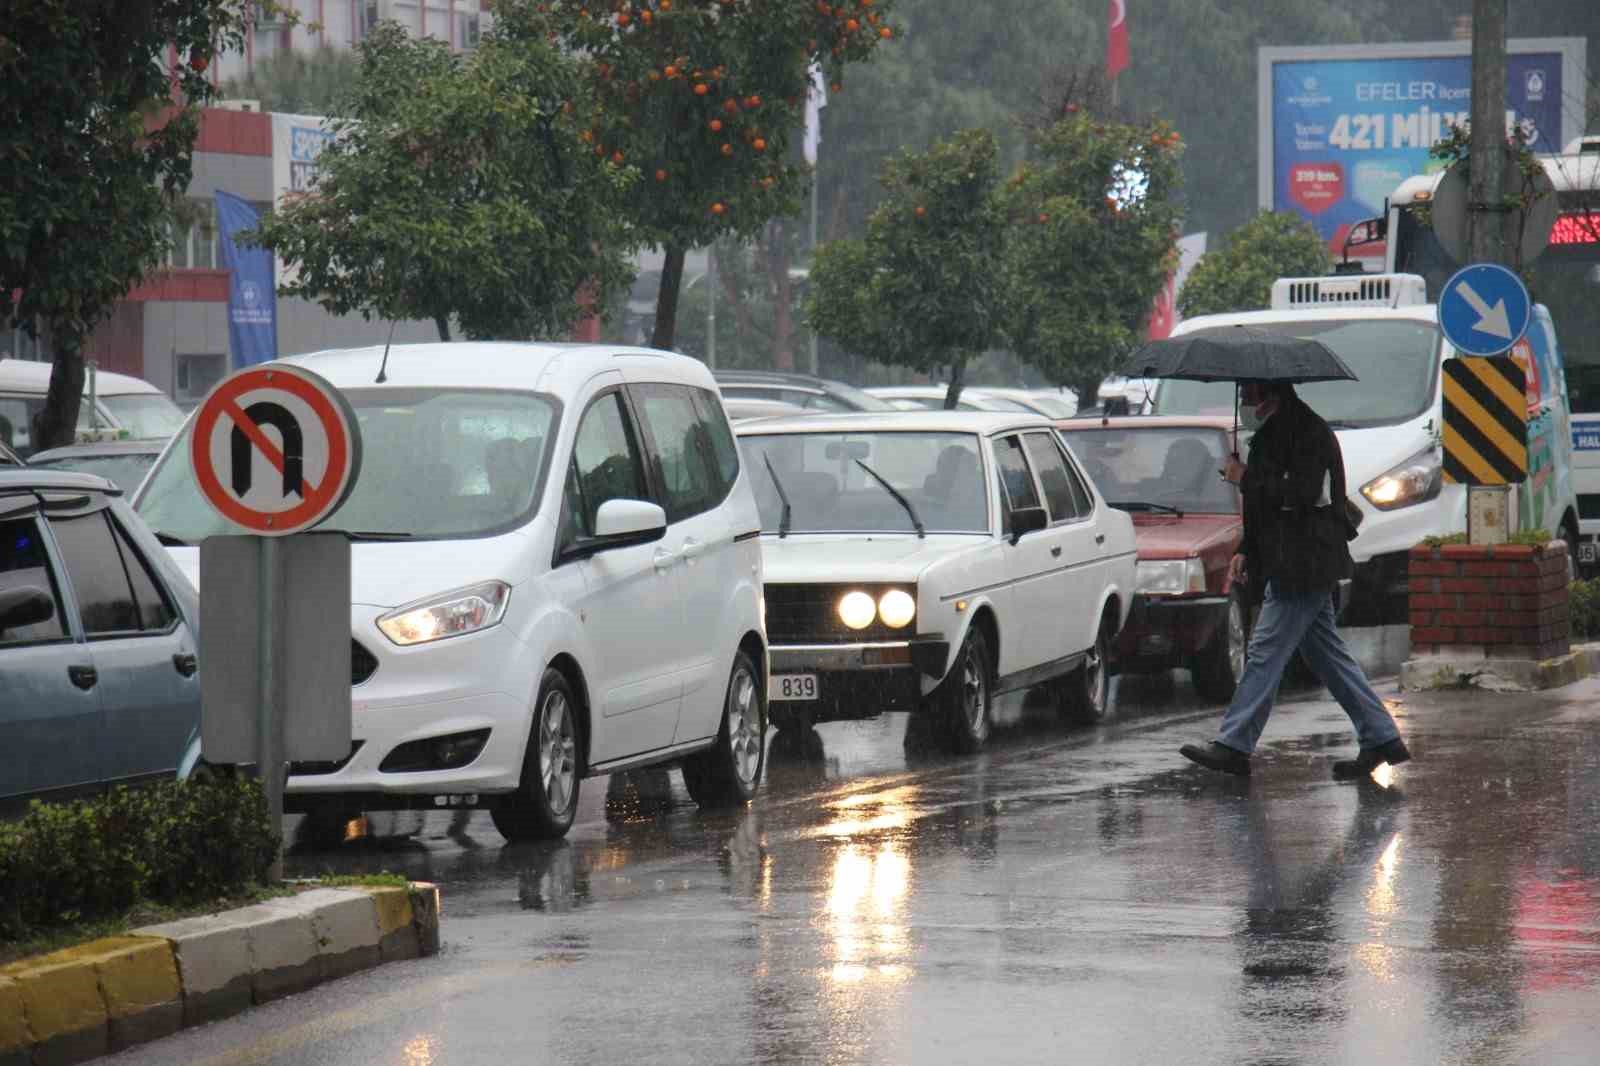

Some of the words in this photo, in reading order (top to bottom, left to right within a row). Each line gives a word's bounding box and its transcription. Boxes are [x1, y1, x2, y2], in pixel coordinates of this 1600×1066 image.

[1355, 81, 1436, 100] EFELER
[1329, 114, 1385, 149] 421
[782, 678, 814, 697] 839
